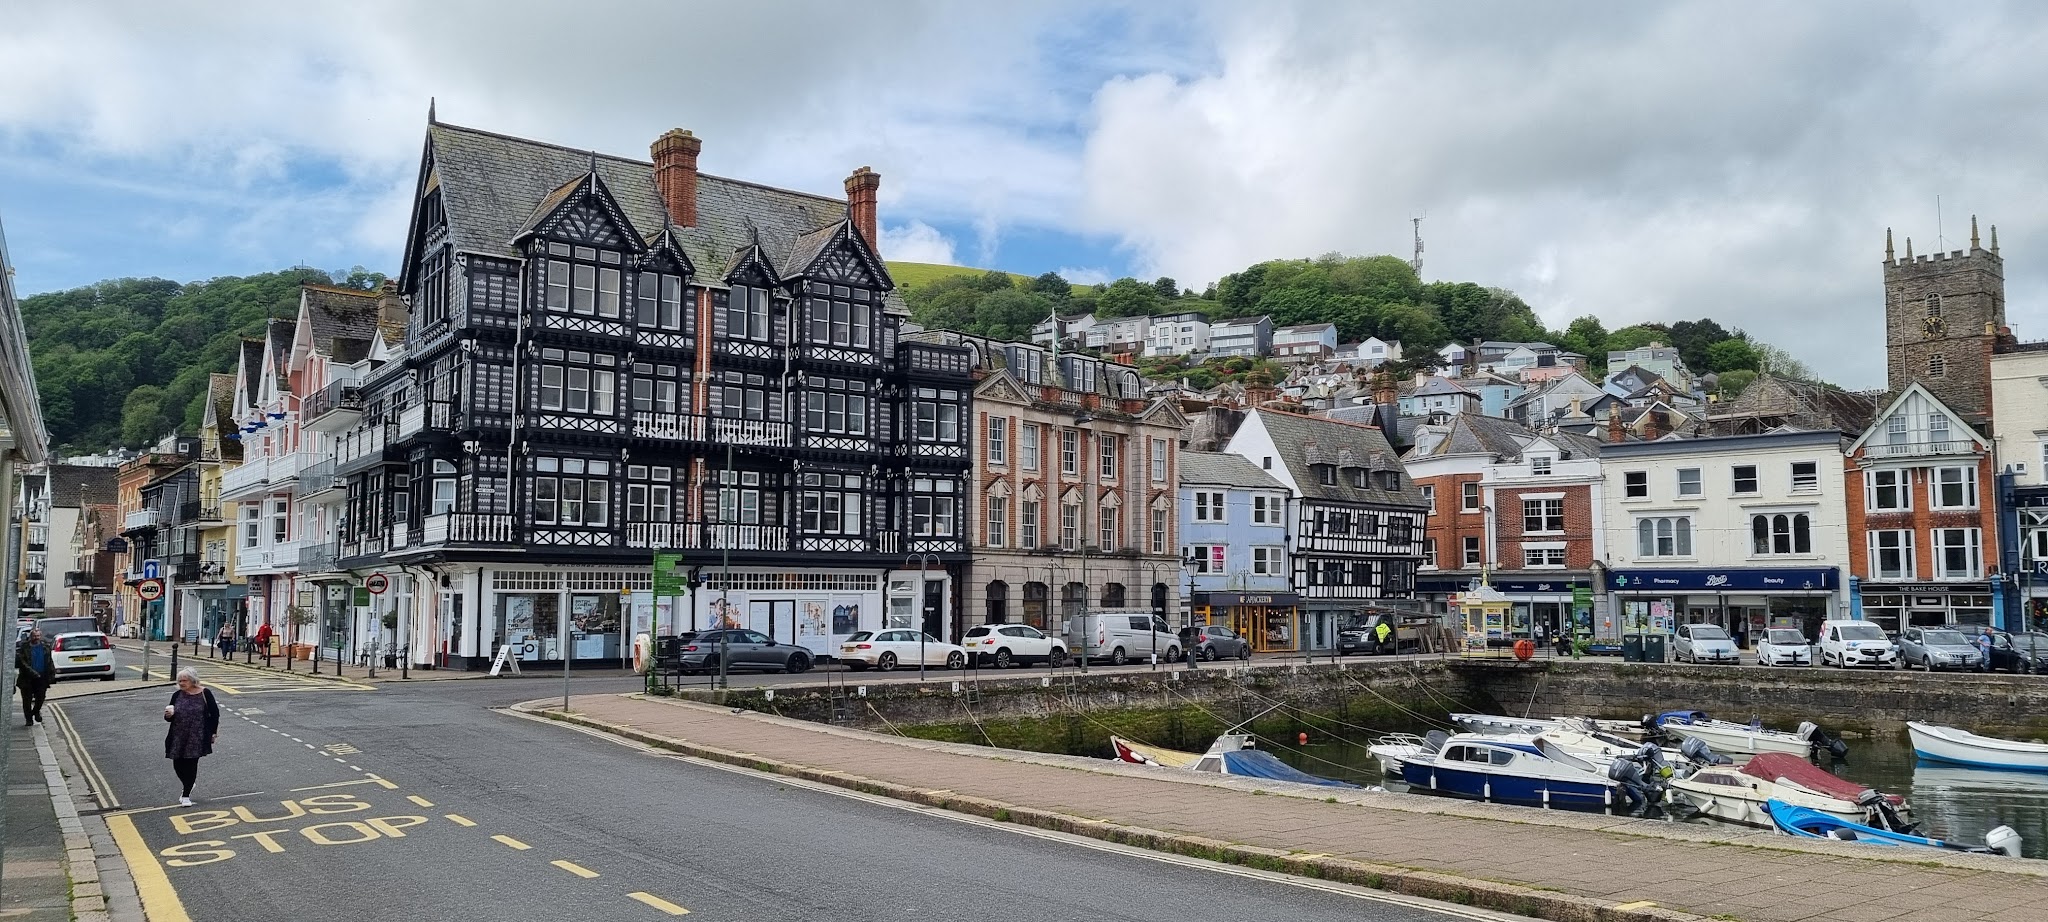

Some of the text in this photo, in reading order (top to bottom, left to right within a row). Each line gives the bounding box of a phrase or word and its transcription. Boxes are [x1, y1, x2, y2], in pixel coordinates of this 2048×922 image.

[2036, 496, 2048, 506] T
[1706, 574, 1728, 586] Boots
[169, 794, 372, 835] BUS
[160, 815, 428, 867] STOP
